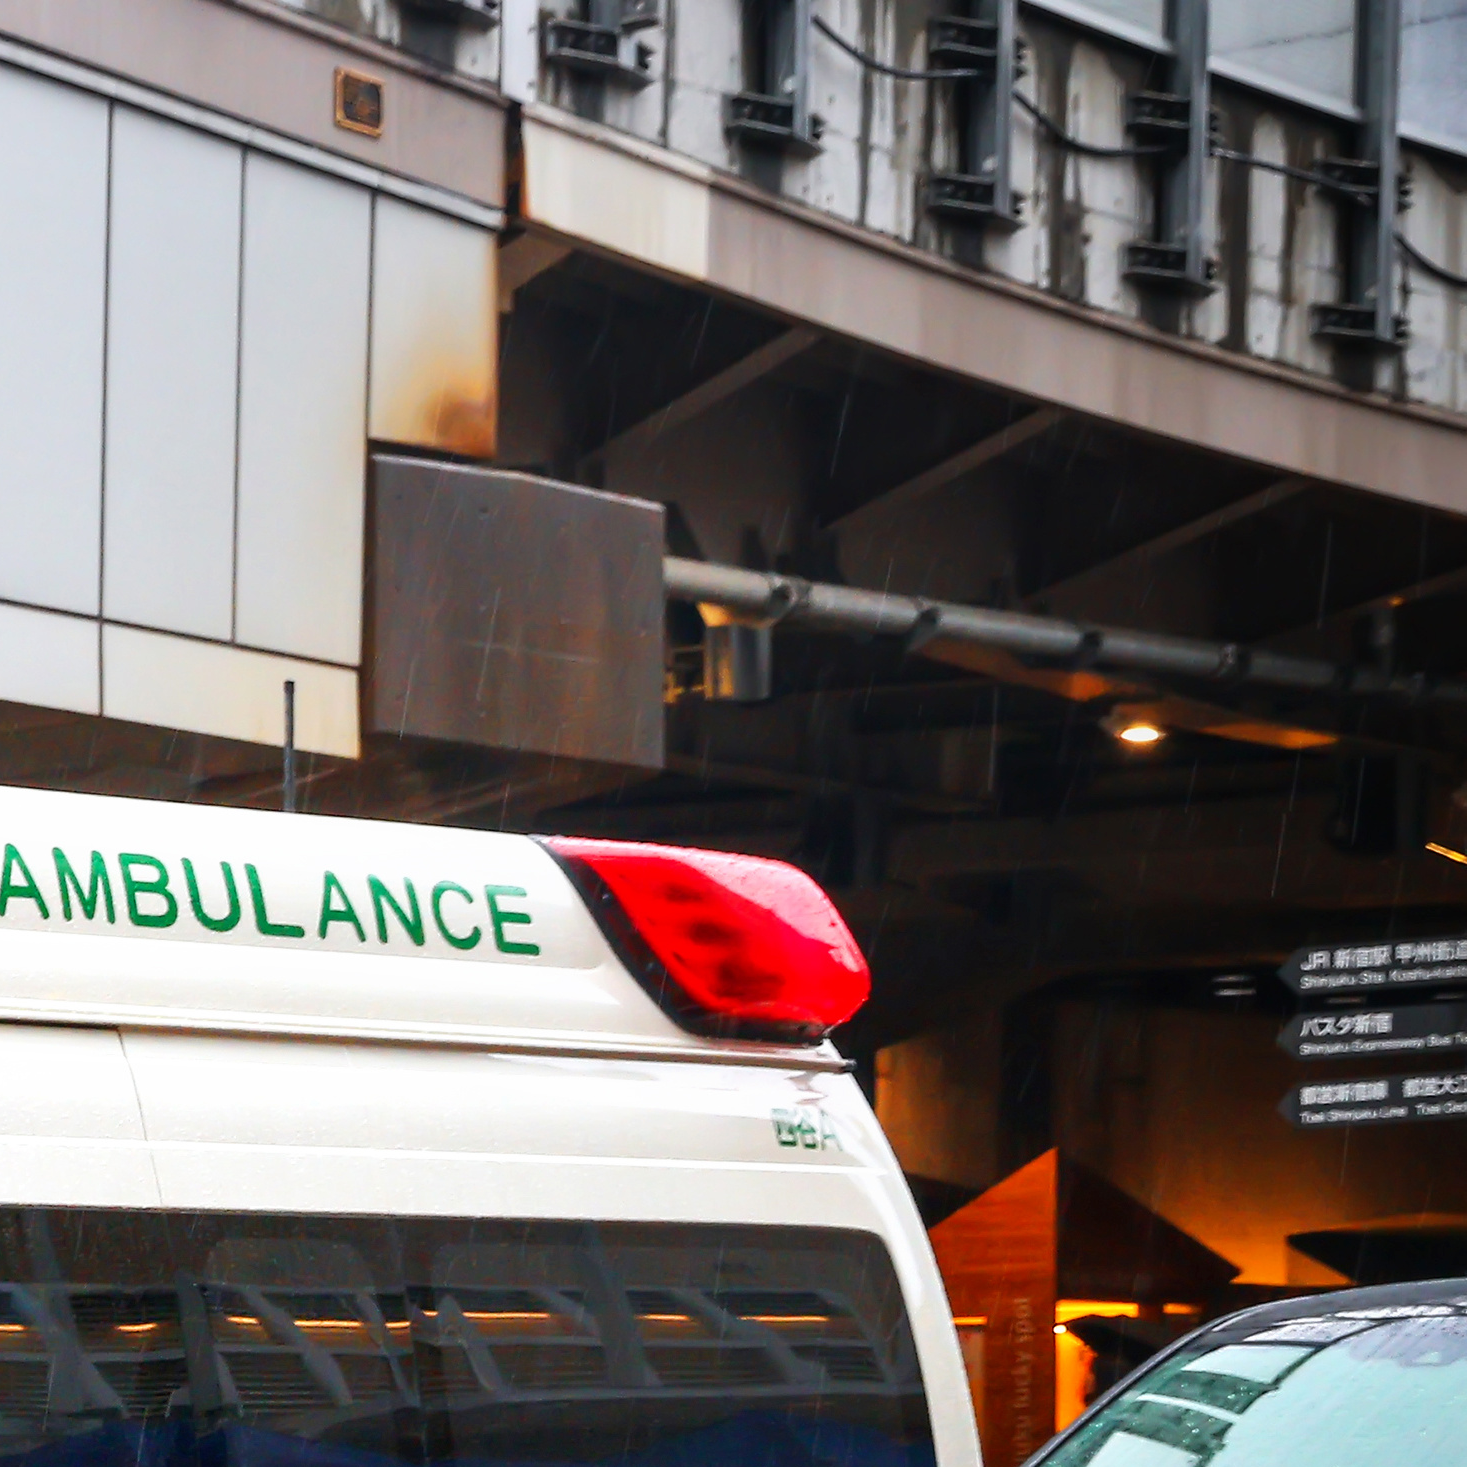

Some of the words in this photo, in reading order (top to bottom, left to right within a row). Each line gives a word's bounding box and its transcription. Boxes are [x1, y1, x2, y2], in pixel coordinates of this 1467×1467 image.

[1300, 951, 1330, 971] JR
[1300, 1012, 1393, 1037] バスタ新宿
